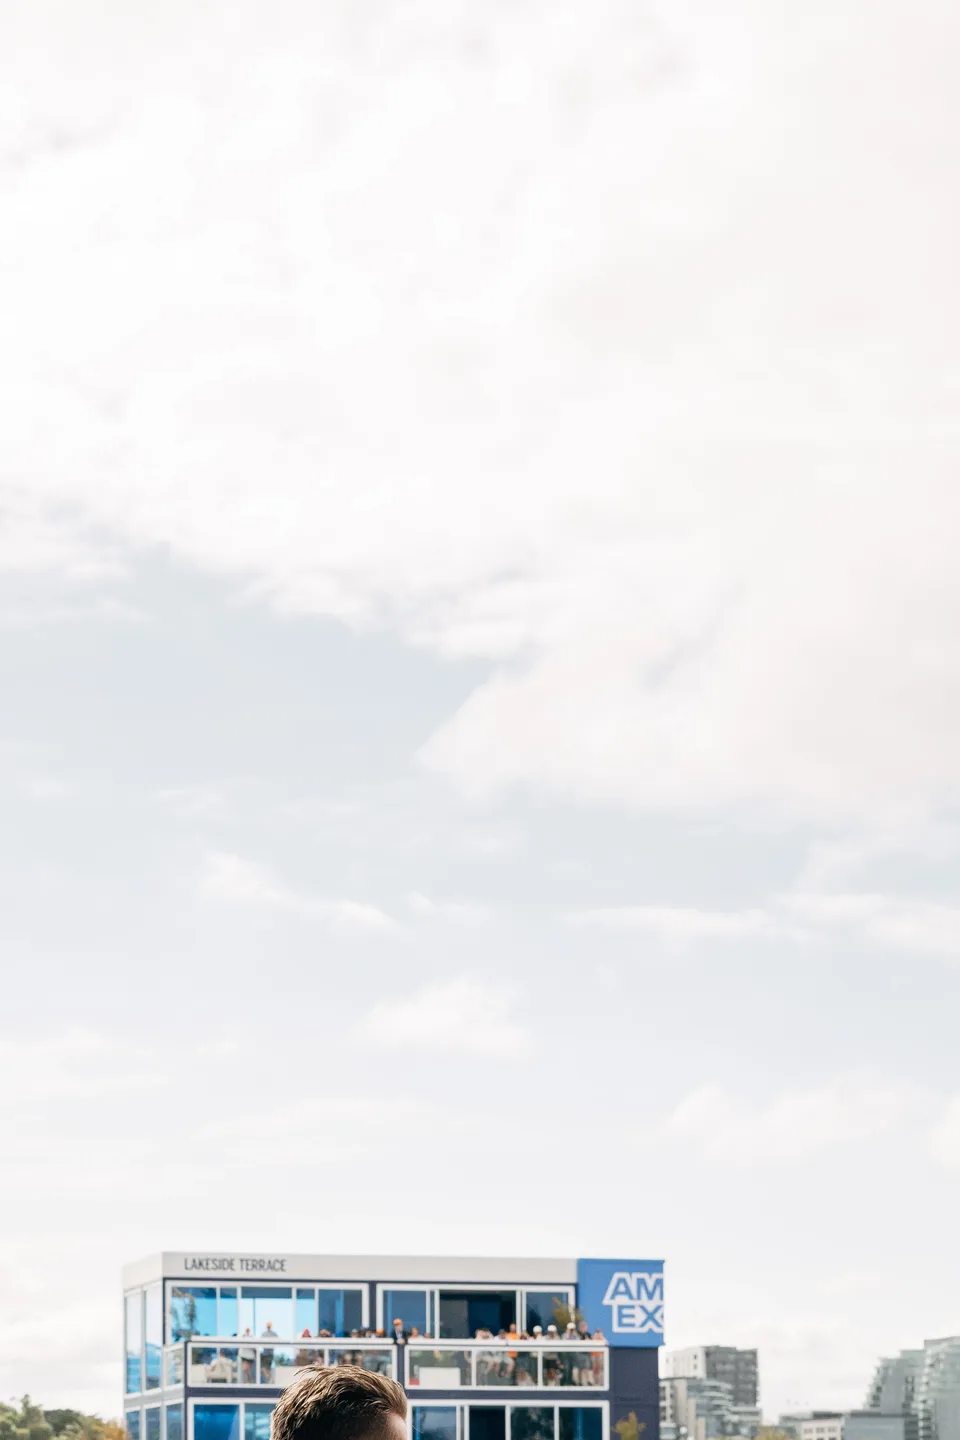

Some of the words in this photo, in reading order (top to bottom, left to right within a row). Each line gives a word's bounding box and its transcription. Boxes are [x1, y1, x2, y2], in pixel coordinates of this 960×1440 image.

[184, 1257, 235, 1271] LAKESIDE
[239, 1258, 287, 1272] TERRACE
[605, 1274, 663, 1303] AM
[614, 1303, 663, 1331] EX
